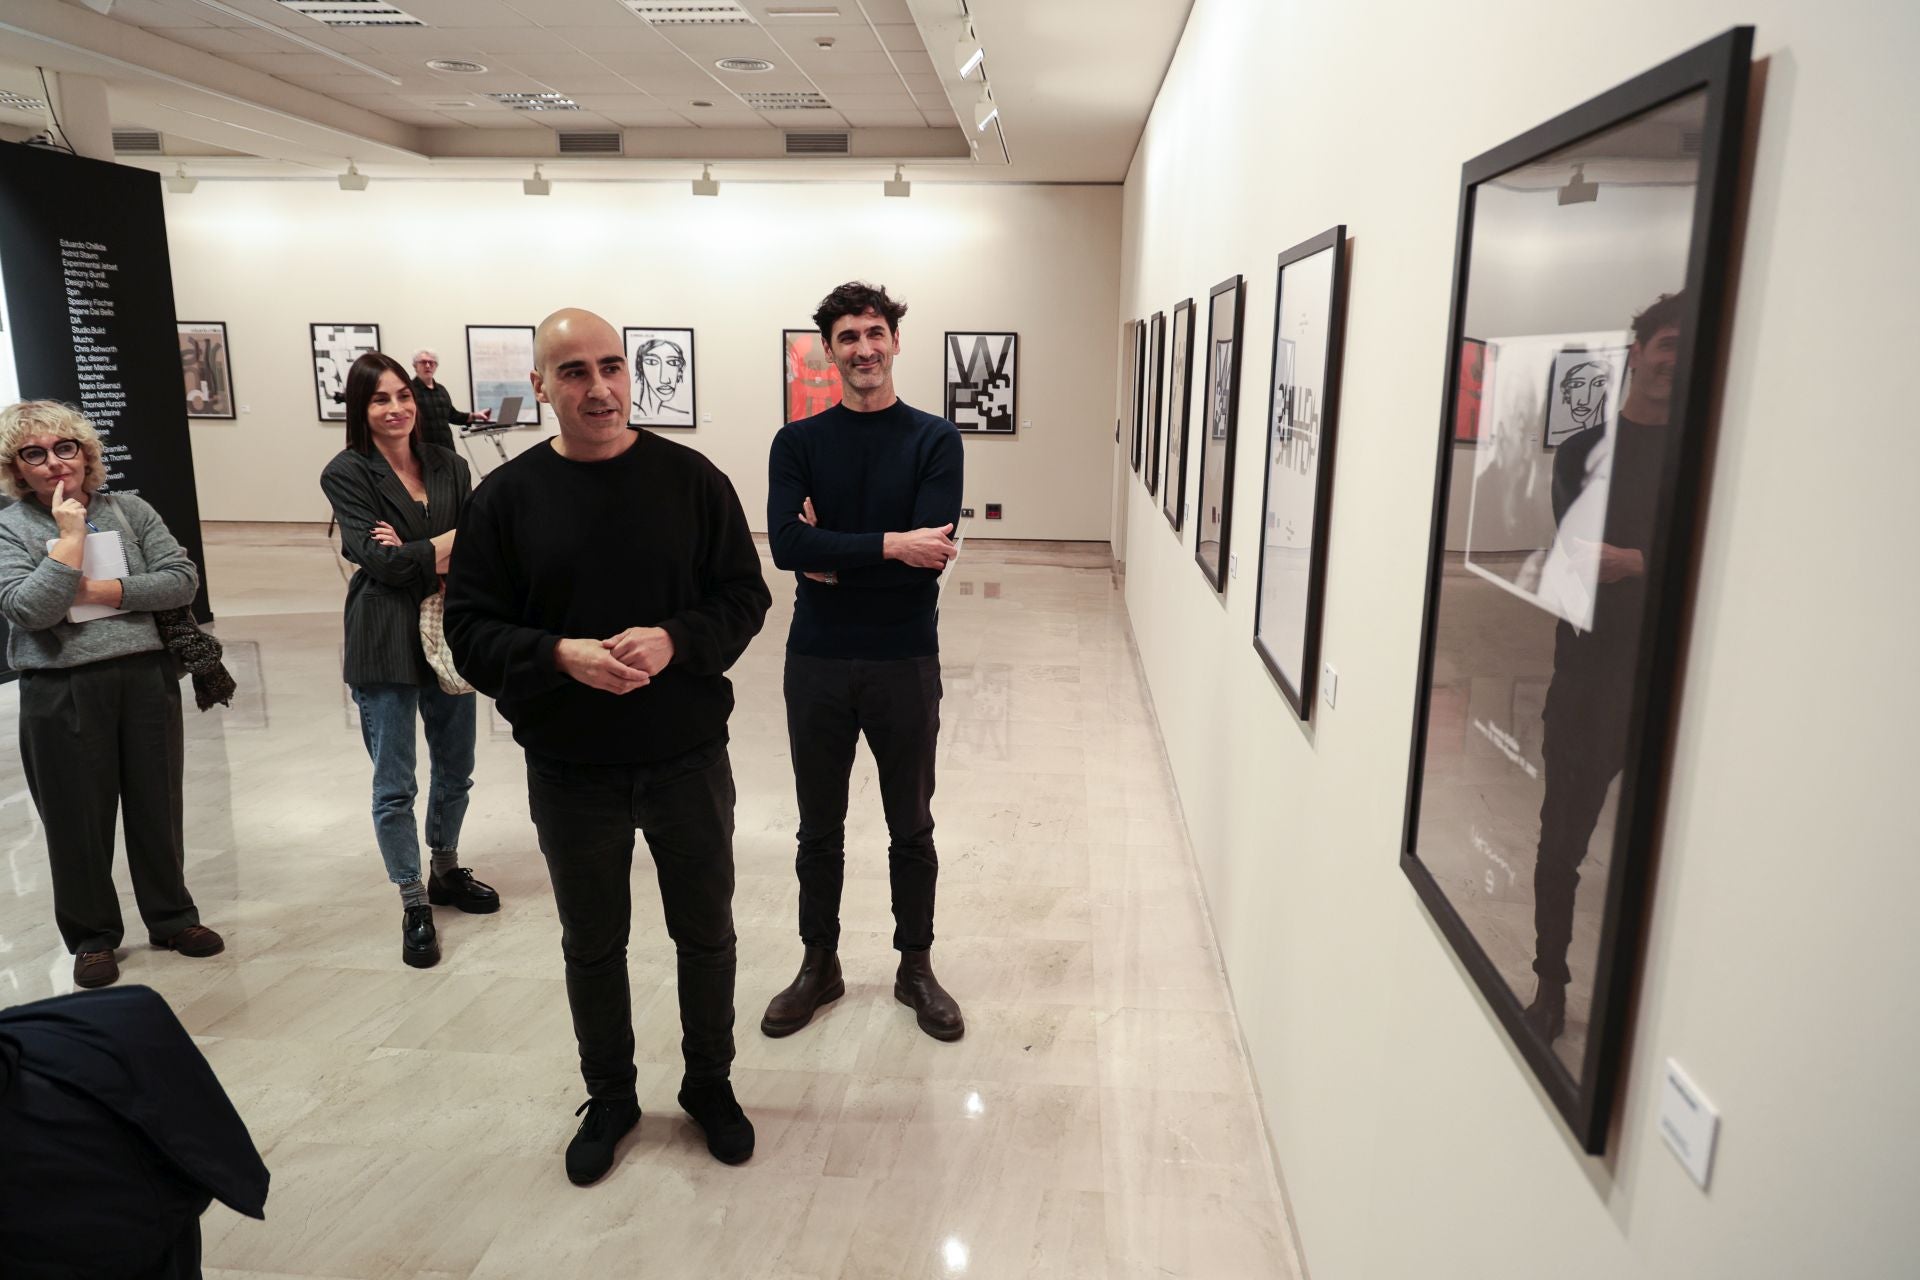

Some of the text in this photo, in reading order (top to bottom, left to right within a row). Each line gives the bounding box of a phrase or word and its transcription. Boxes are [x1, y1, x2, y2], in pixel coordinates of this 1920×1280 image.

[59, 238, 107, 251] Eduardo Chillida
[61, 249, 99, 259] Astrid Stavro
[62, 258, 118, 271] Experimental Jetset
[64, 268, 89, 279] Anthony
[65, 277, 86, 288] Design
[86, 280, 94, 289] by
[66, 287, 81, 296] Spin
[67, 297, 114, 307] Spassky Fischer
[68, 307, 89, 316] Rejane
[70, 316, 82, 324] DIA
[72, 335, 94, 343] Mucho
[74, 344, 90, 352] Chris
[93, 363, 118, 371] Mariscal
[79, 381, 121, 390] Mario Eskenazi
[81, 391, 126, 399] Julian Montague
[97, 418, 114, 427] König
[103, 444, 128, 453] Gramlich
[109, 454, 132, 462] Thomas
